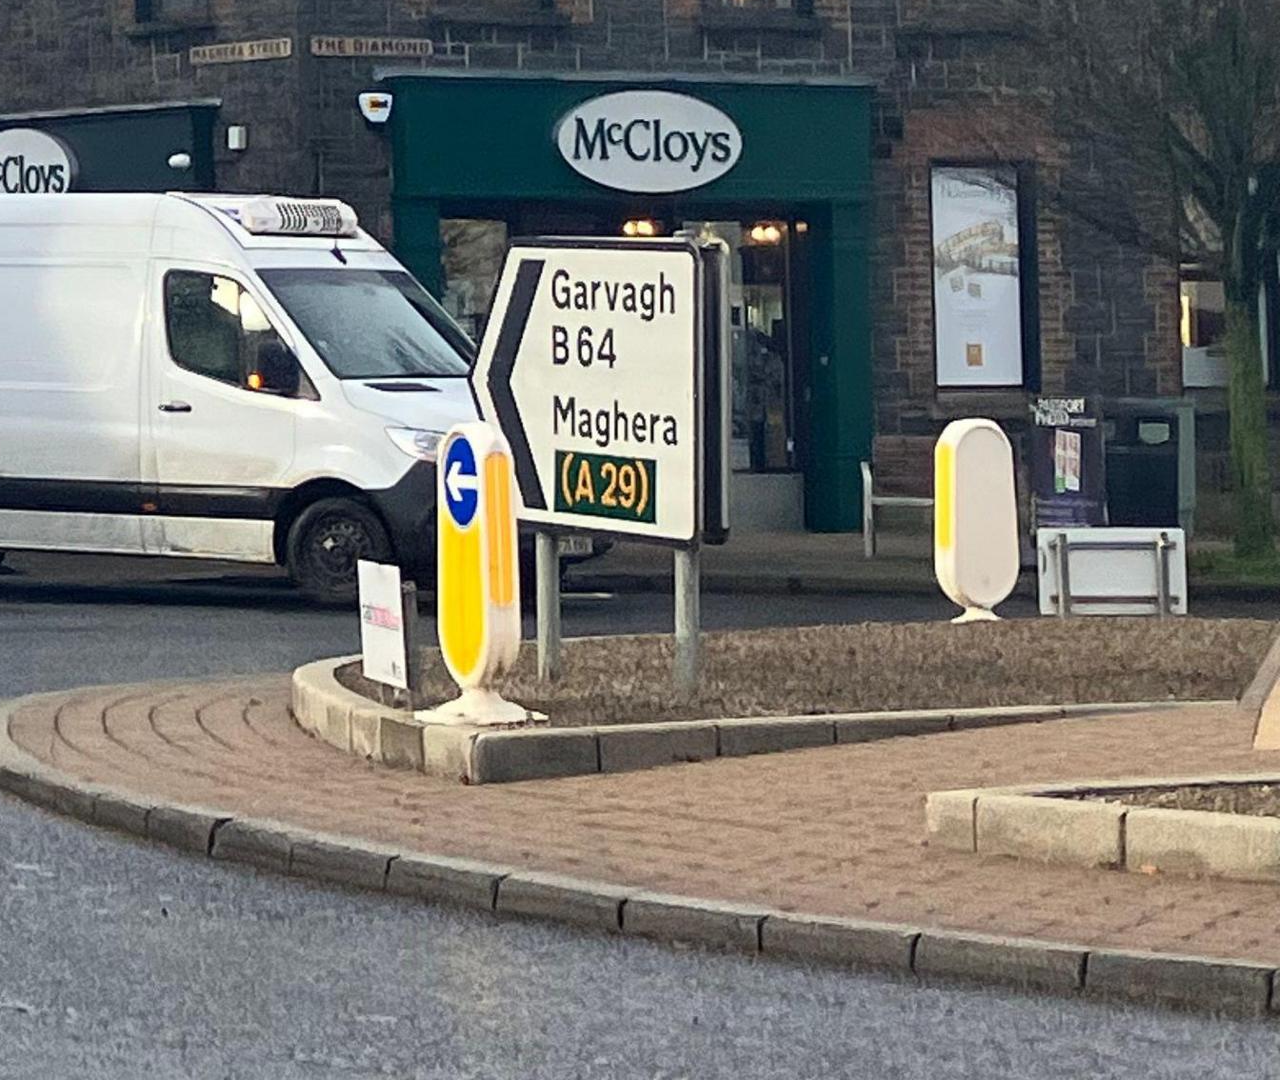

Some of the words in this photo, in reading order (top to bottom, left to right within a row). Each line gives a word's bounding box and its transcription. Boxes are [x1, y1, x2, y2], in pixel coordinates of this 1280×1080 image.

[248, 39, 289, 57] STREET
[315, 38, 346, 54] THE
[352, 38, 430, 55] DIAMOND
[573, 116, 732, 173] McCloys
[551, 269, 676, 322] Garvagh
[552, 395, 679, 448] Maghera
